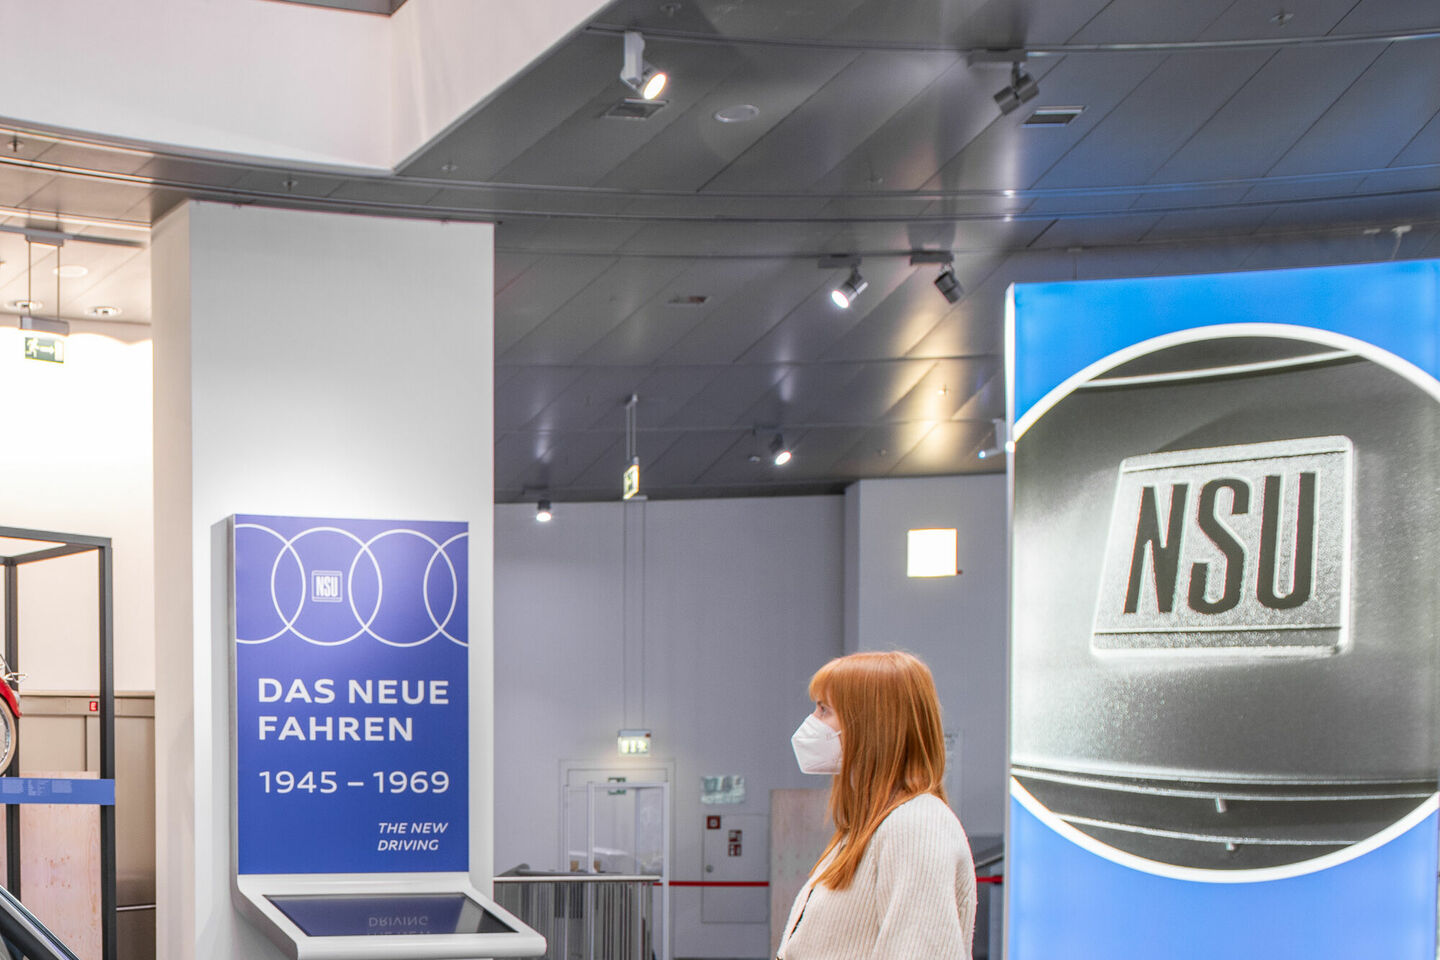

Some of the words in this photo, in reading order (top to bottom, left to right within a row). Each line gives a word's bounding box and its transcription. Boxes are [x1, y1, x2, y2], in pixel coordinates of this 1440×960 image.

[1122, 472, 1318, 616] NSU
[315, 574, 339, 598] NSU
[258, 678, 336, 704] DAS
[348, 679, 449, 705] NEUE
[258, 716, 413, 742] FAHREN
[259, 770, 338, 794] 1945
[372, 770, 450, 794] 1969
[378, 822, 407, 834] THE
[410, 822, 449, 834] NEW
[377, 839, 439, 852] DRIVING
